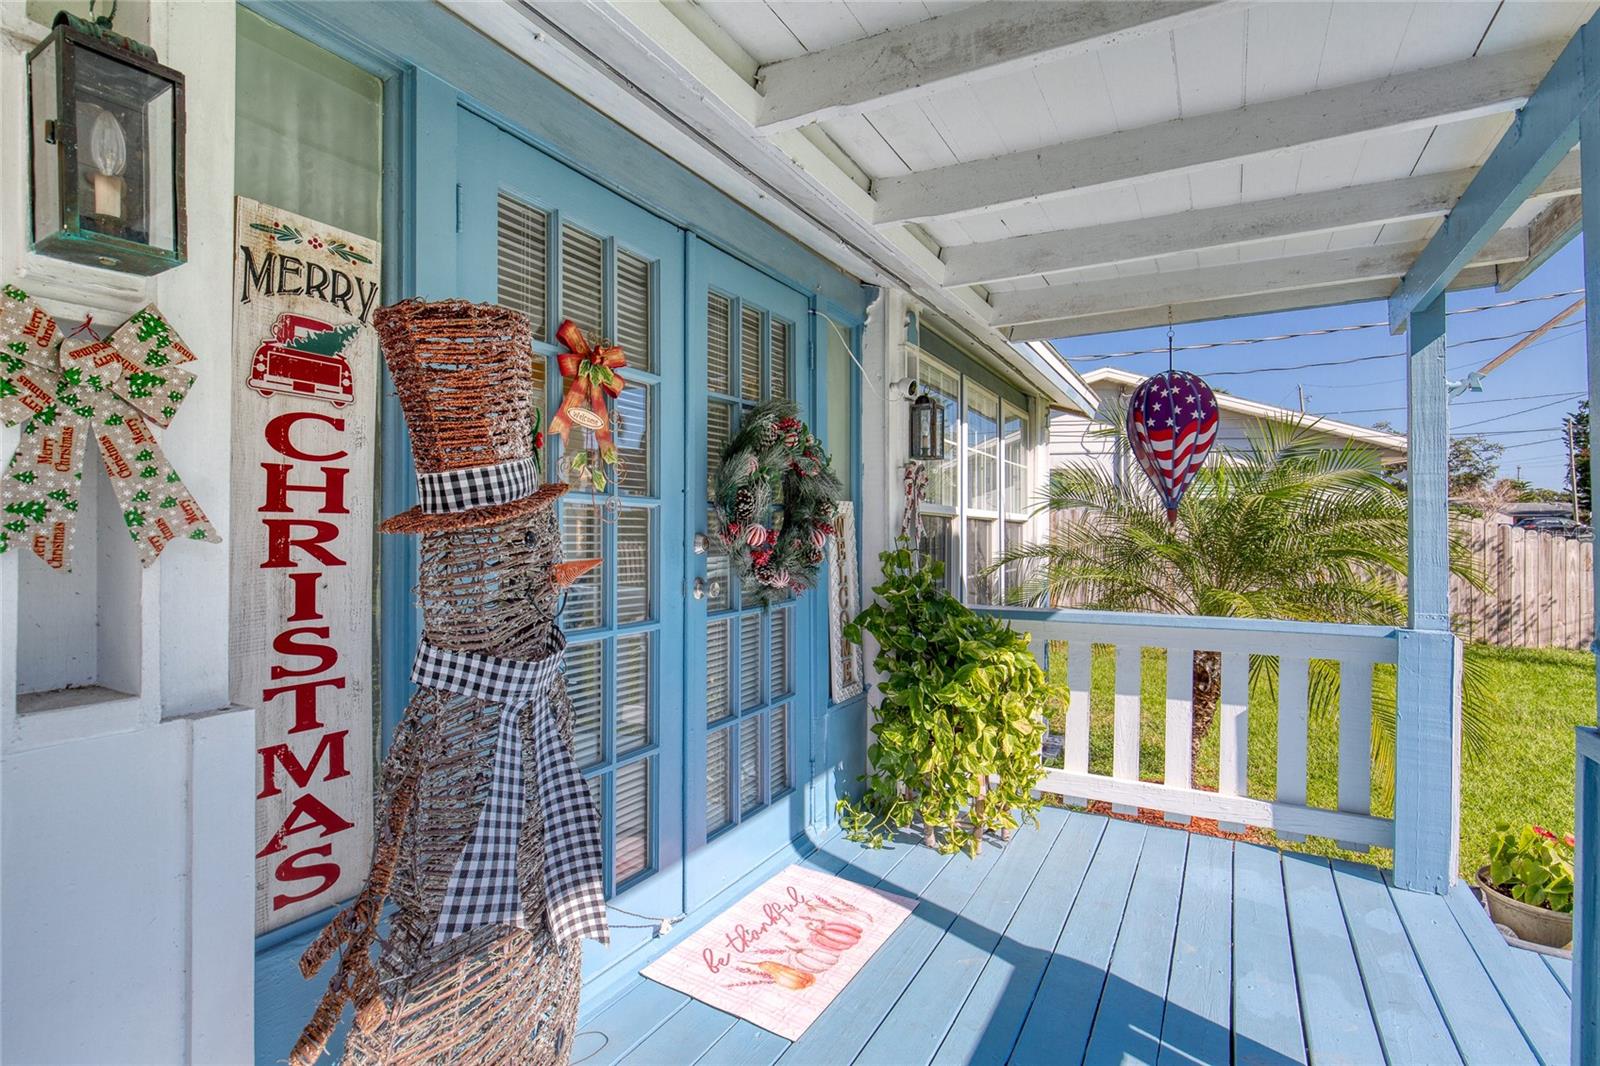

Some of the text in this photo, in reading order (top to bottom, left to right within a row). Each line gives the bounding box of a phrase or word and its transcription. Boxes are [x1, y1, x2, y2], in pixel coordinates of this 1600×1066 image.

[240, 245, 379, 328] MERRY
[54, 426, 74, 472] Christmas
[99, 434, 132, 478] Christmas
[47, 521, 65, 569] Christmas
[255, 411, 355, 911] CHRISTMAS
[703, 886, 806, 974] be thankful
